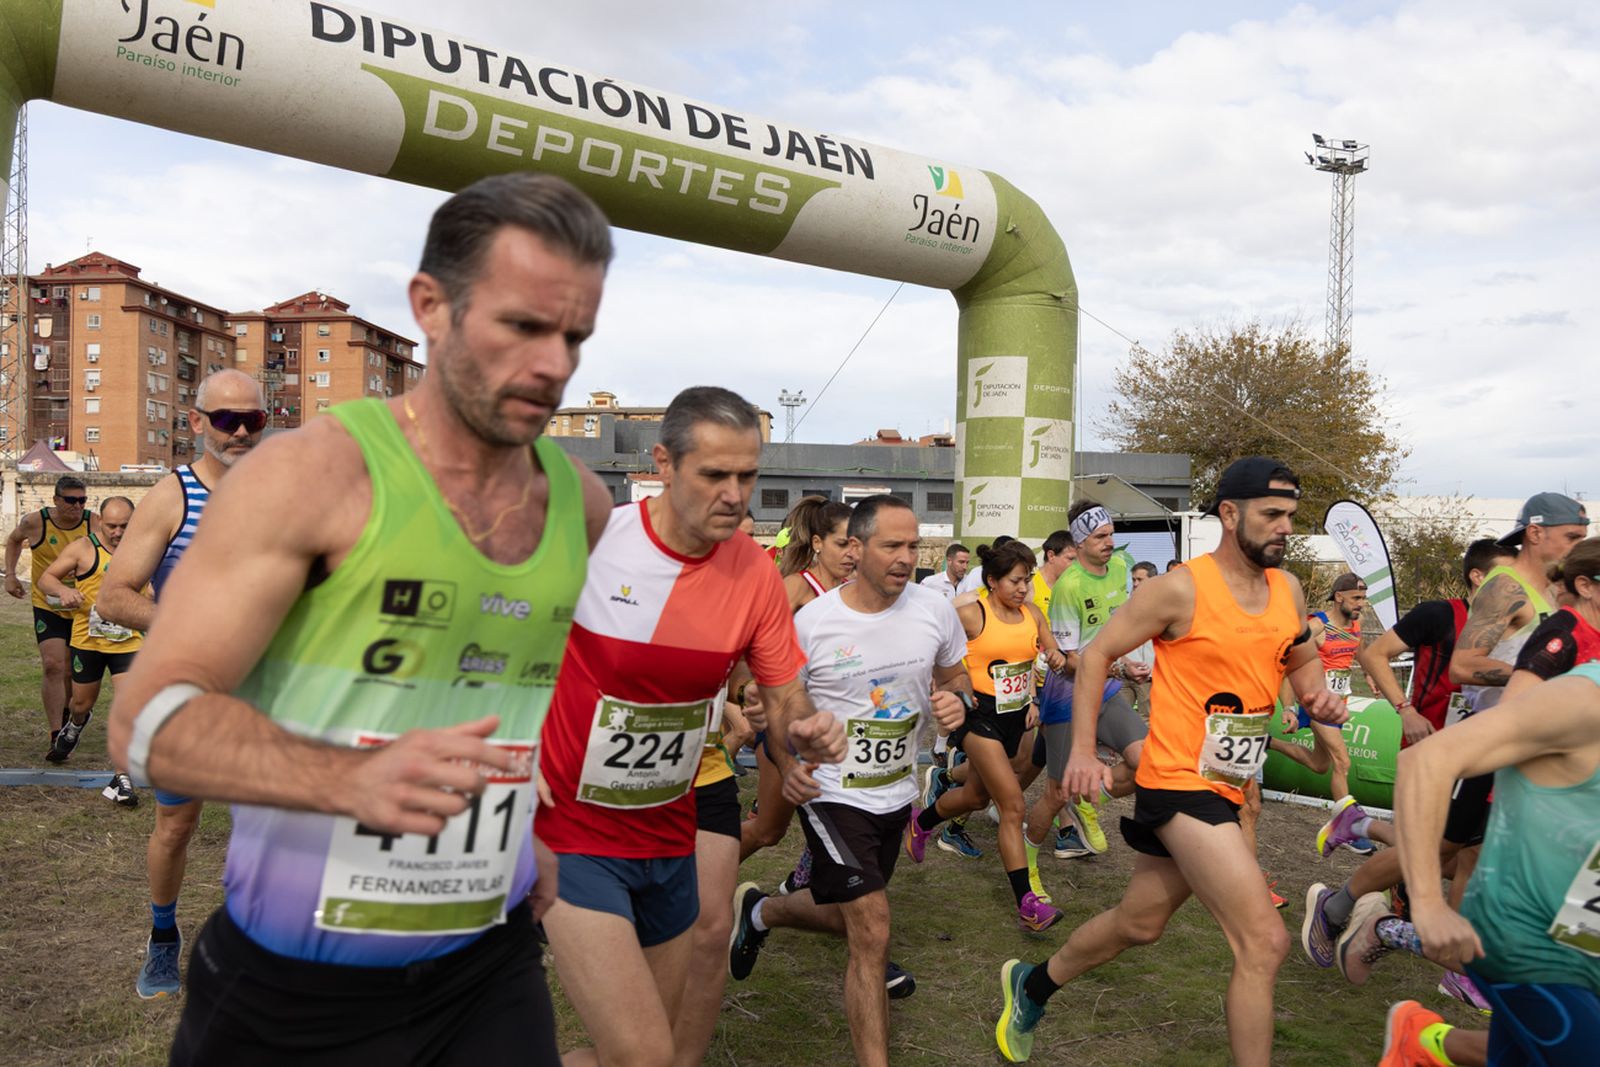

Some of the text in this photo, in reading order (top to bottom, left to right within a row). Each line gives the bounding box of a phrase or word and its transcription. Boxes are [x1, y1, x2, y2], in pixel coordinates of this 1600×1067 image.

[118, 0, 245, 71] Jaén
[116, 45, 242, 88] Paraíso interior
[309, 1, 876, 180] DIPUTACIÓN DE JAÉN
[422, 89, 791, 215] DEPORTES
[908, 193, 980, 243] Jaén
[940, 240, 974, 255] interior
[1033, 384, 1071, 394] DEPORTES
[1027, 504, 1067, 513] DEPORTES
[480, 592, 531, 620] vive
[1002, 673, 1028, 694] 328
[1330, 677, 1348, 690] 187
[1341, 716, 1370, 745] én
[603, 732, 686, 770] 224
[854, 736, 907, 764] 365
[1214, 736, 1266, 765] 327
[1291, 737, 1378, 760] PARA ERIOR
[626, 770, 660, 778] Antonio
[388, 859, 489, 872] FRANCISCO JAVIER
[349, 874, 463, 895] FERNANDEZ
